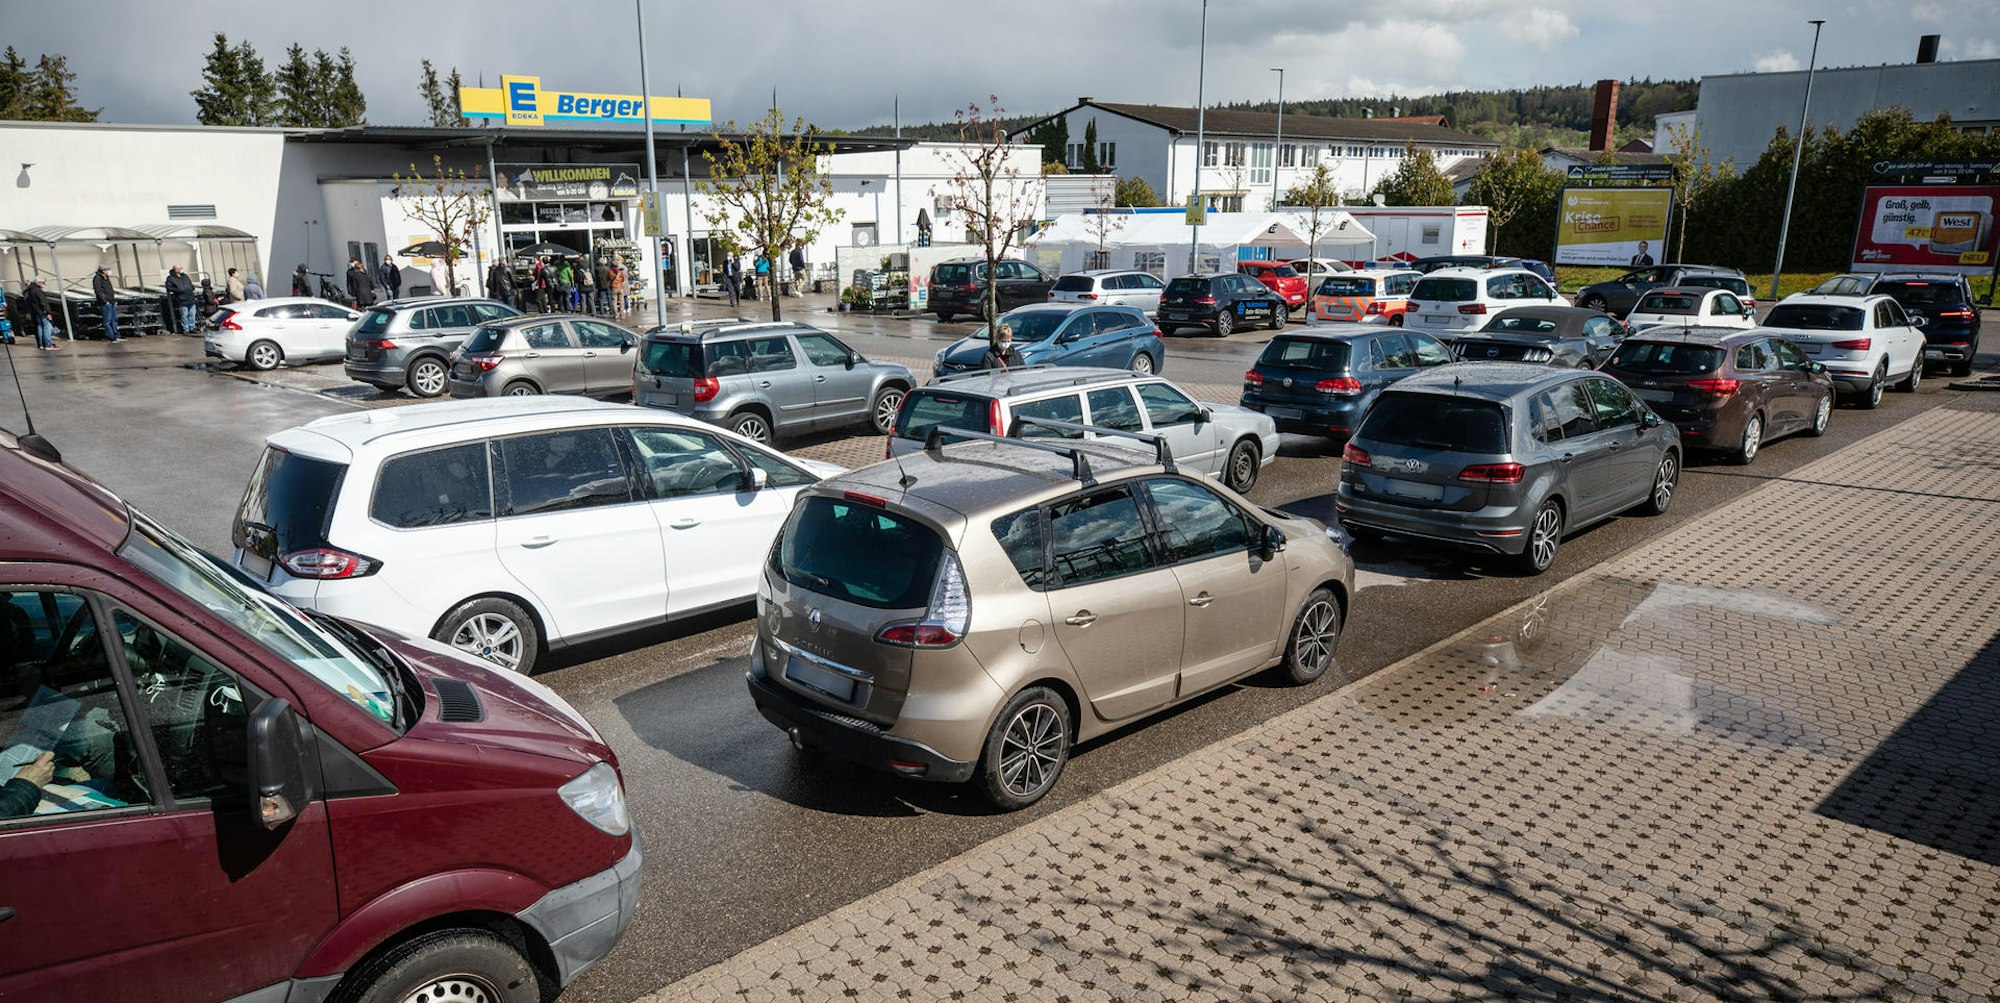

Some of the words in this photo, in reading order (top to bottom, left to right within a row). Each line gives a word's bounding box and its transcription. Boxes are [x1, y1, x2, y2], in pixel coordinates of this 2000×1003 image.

[509, 82, 537, 111] E
[557, 94, 642, 118] Berger
[532, 167, 611, 183] WILLKOMMEN
[1885, 200, 1909, 211] Groß,
[1910, 200, 1931, 211] gelb,
[1565, 211, 1601, 224] Krise
[1882, 212, 1918, 224] günstig.
[1943, 217, 1972, 227] West
[1578, 221, 1616, 231] Chance
